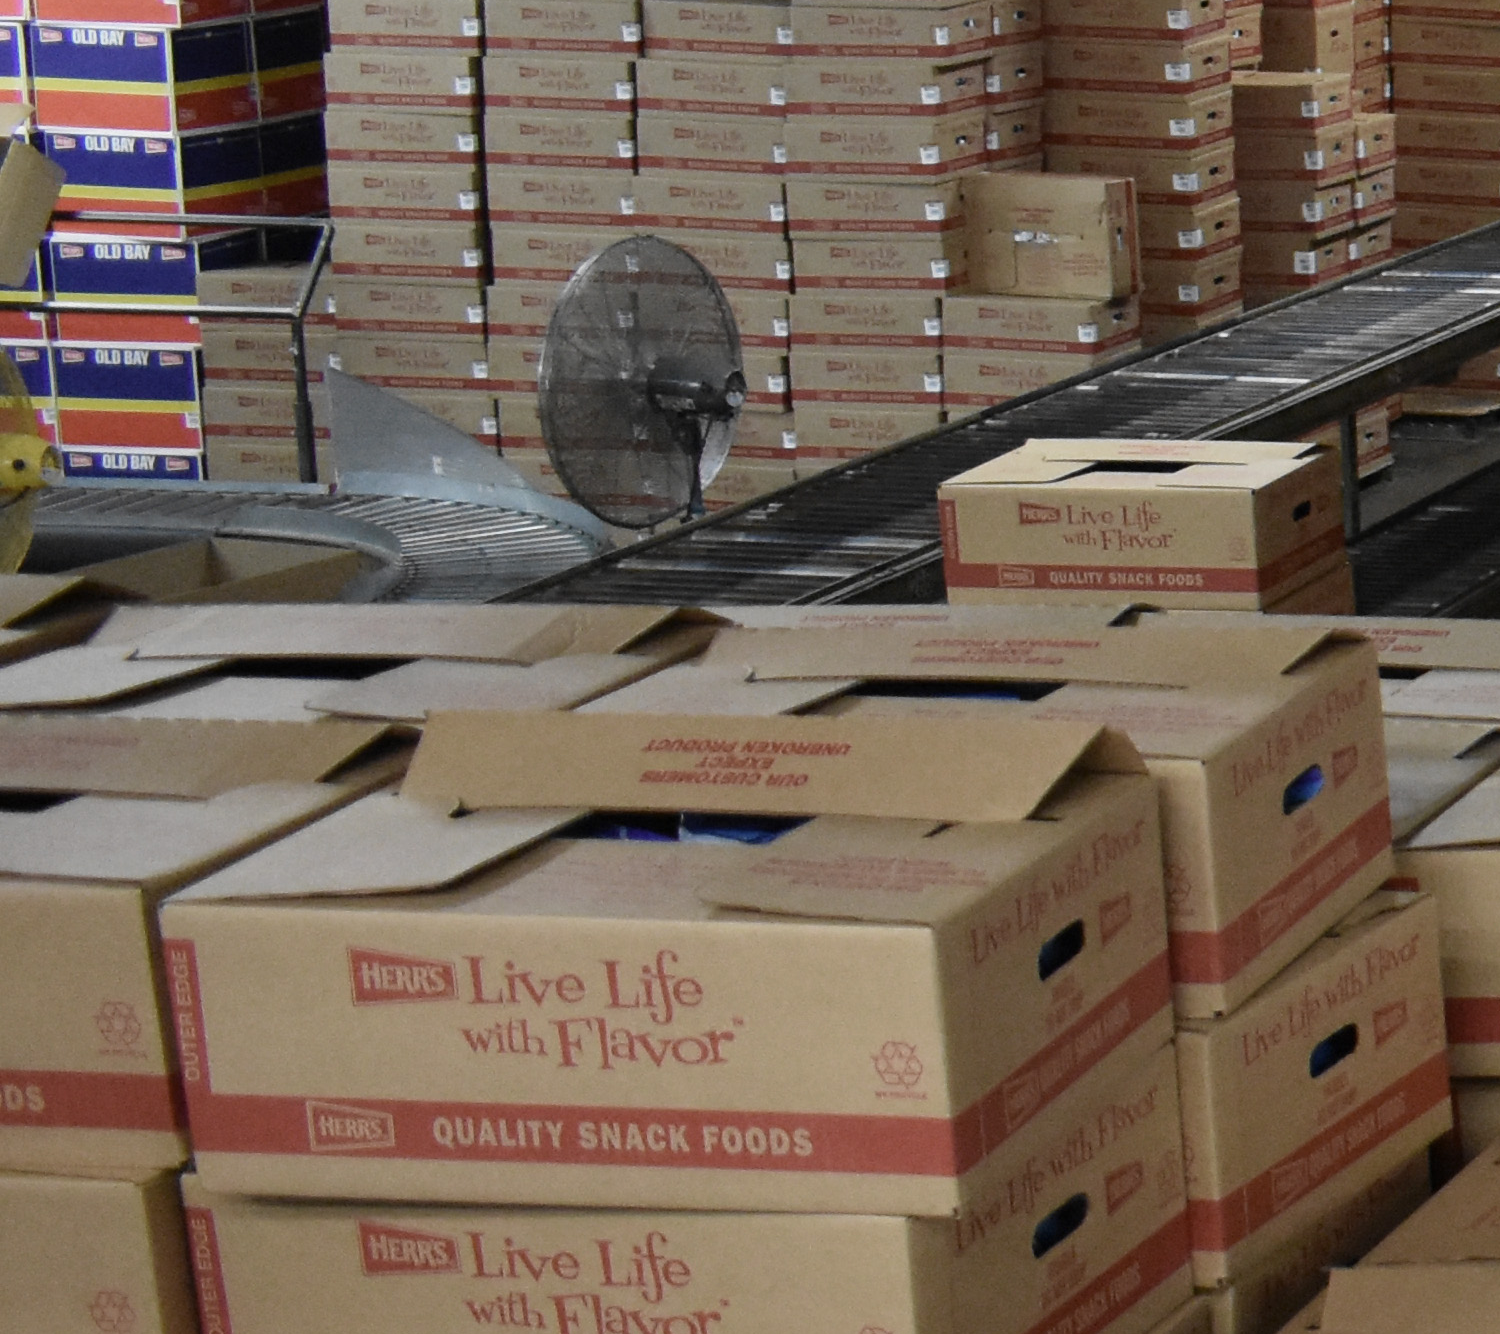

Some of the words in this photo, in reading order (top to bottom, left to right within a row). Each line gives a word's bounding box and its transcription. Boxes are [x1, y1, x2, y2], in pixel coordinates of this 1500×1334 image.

[85, 135, 109, 151] OLD
[112, 136, 135, 153] BAY
[95, 244, 122, 259] OLD
[126, 244, 150, 260] BAY
[103, 453, 127, 469] OLD
[131, 455, 155, 470] BAY
[1066, 504, 1113, 526] Live
[1121, 501, 1161, 532] Life
[1063, 530, 1098, 546] with
[1050, 571, 1101, 586] QUALITY
[1109, 572, 1153, 586] SNACK
[1158, 573, 1204, 587] FOODS
[172, 948, 189, 1008] EDGE
[461, 956, 586, 1006] Live
[603, 949, 703, 1025] Life
[181, 1014, 199, 1079] OUTER
[462, 1021, 548, 1057] with
[550, 1016, 734, 1070] Flavor
[433, 1116, 564, 1148] QUALITY
[579, 1119, 689, 1153] SNACK
[704, 1122, 812, 1157] FOODS
